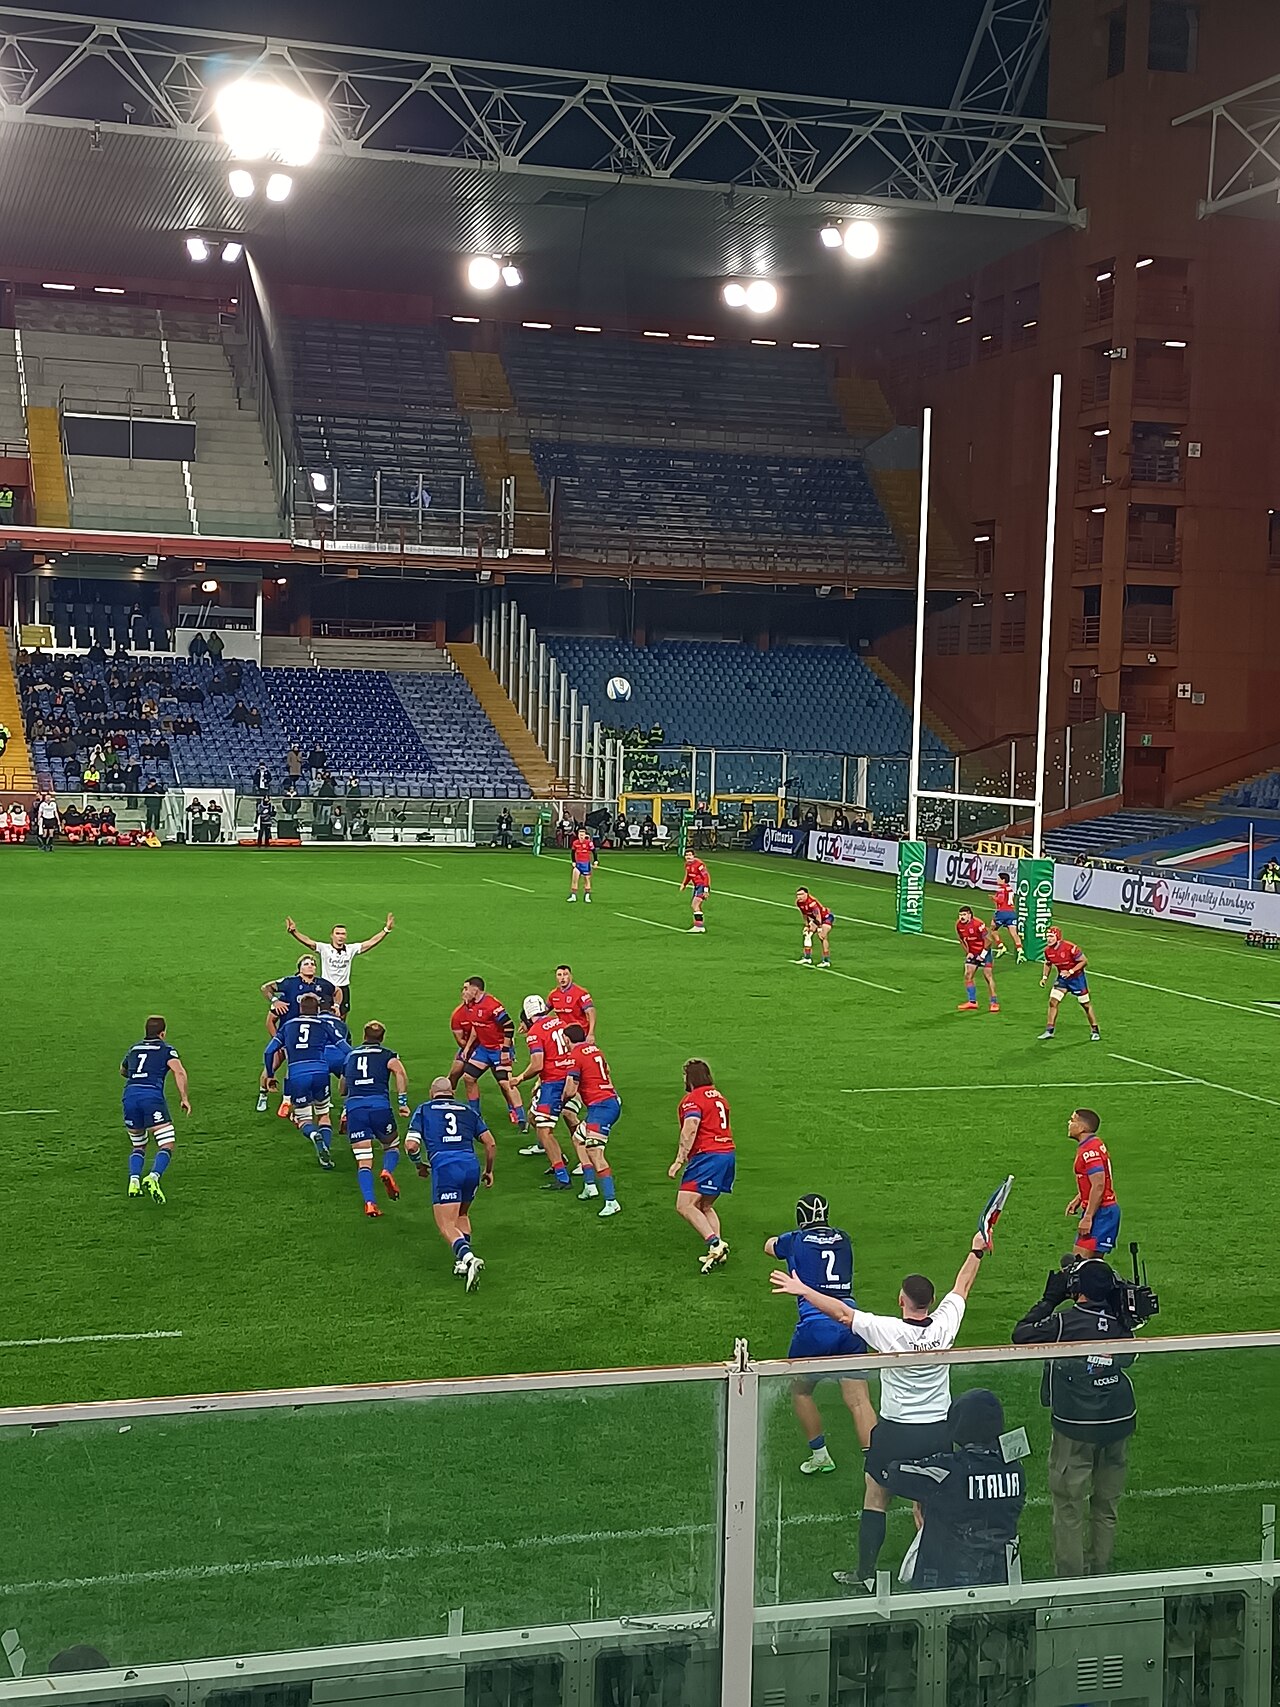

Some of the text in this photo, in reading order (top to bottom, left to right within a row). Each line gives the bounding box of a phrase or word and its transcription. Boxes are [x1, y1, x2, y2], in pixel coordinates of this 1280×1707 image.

[903, 861, 924, 915] Quilter
[1171, 886, 1190, 906] High
[1190, 888, 1218, 911] quality
[1017, 879, 1030, 940] Quilter
[1033, 880, 1053, 941] Quilter
[298, 1024, 310, 1043] 5
[137, 1053, 148, 1073] 7
[357, 1056, 368, 1078] 4
[444, 1112, 458, 1135] 3
[715, 1100, 727, 1130] 3
[350, 1130, 365, 1139] AVIS
[440, 1191, 458, 1201] AVIS
[821, 1250, 840, 1281] 2
[968, 1472, 1020, 1500] ITALIA
